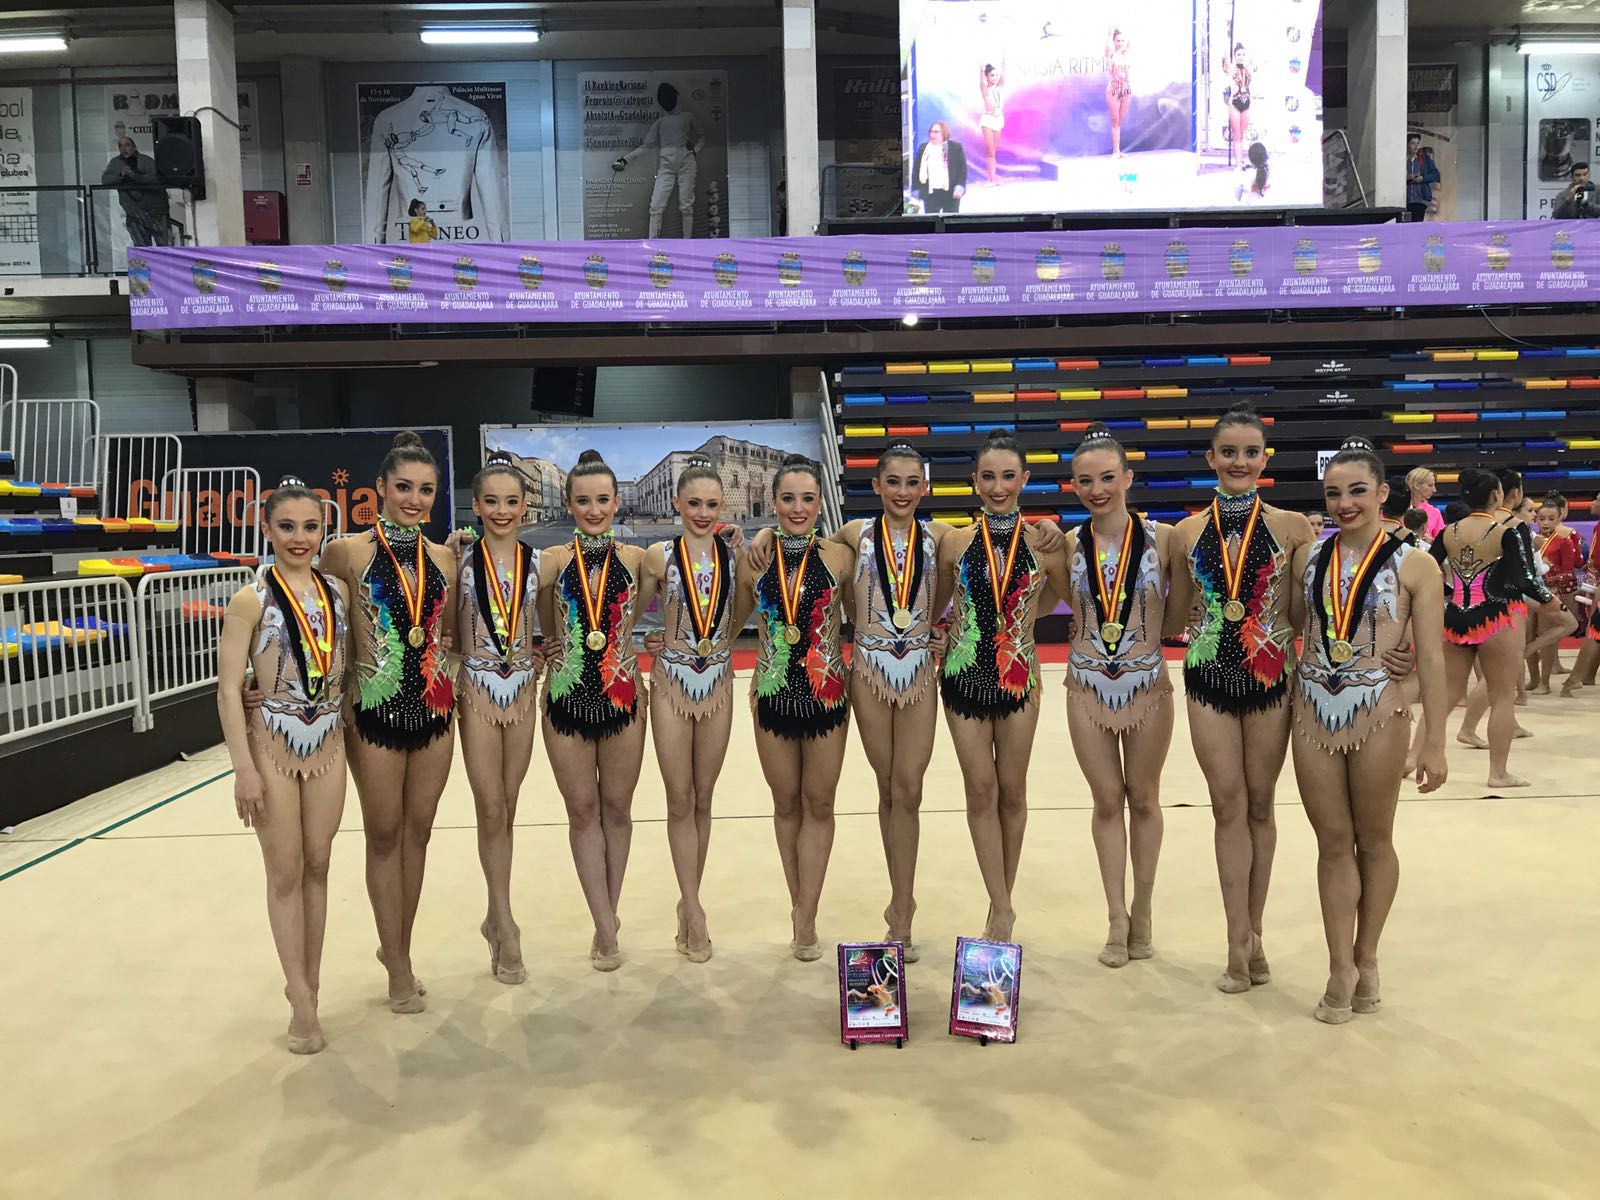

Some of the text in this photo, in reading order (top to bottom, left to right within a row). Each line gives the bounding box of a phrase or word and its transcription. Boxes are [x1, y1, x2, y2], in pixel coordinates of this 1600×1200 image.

[1536, 72, 1557, 92] CSD
[395, 222, 480, 241] TNEO
[1347, 276, 1391, 284] AYUNTAMIENTO
[1411, 274, 1456, 282] AYUNTAMIENTO
[1476, 273, 1521, 281] AYUNTAMIENTO
[1540, 272, 1584, 280] AYUNTAMIENTO
[1090, 282, 1135, 291] AYUNTAMIENTO
[1155, 281, 1199, 289] AYUNTAMIENTO
[1219, 279, 1263, 287] AYUNTAMIENTO
[1283, 278, 1328, 286] AYUNTAMIENTO
[1537, 280, 1588, 290] DE GUADALAJARA
[961, 286, 1006, 294] AYUNTAMIENTO
[1026, 284, 1070, 293] AYUNTAMIENTO
[1280, 286, 1331, 296] DE GUADALAJARA
[1355, 285, 1395, 294] GUADALAJARA
[1408, 283, 1459, 293] DE GUADALAJARA
[1484, 282, 1524, 292] GUADALAJARA
[444, 292, 489, 300] AYUNTAMIENTO
[509, 292, 554, 300] AYUNTAMIENTO
[639, 291, 684, 299] AYUNTAMIENTO
[704, 291, 748, 299] AYUNTAMIENTO
[768, 290, 813, 298] AYUNTAMIENTO
[832, 289, 877, 297] AYUNTAMIENTO
[897, 288, 941, 296] AYUNTAMIENTO
[1087, 291, 1138, 301] DE GUADALAJARA
[1163, 290, 1203, 299] GUADALAJARA
[1227, 288, 1267, 298] GUADALAJARA
[184, 296, 229, 304] AYUNTAMIENTO
[249, 294, 294, 302] AYUNTAMIENTO
[379, 293, 424, 301] AYUNTAMIENTO
[905, 297, 945, 306] GUADALAJARA
[969, 295, 1009, 304] GUADALAJARA
[1022, 293, 1074, 303] DE GUADALAJARA
[323, 302, 364, 312] GUADALAJARA
[387, 301, 428, 311] GUADALAJARA
[441, 301, 493, 311] DE GUADALAJARA
[506, 301, 558, 311] DE GUADALAJARA
[583, 301, 623, 310] GUADALAJARA
[647, 300, 688, 310] GUADALAJARA
[701, 300, 752, 309] DE GUADALAJARA
[776, 299, 816, 308] GUADALAJARA
[840, 298, 881, 308] GUADALAJARA
[193, 305, 233, 314] GUADALAJARA
[246, 303, 298, 313] DE GUADALAJARA
